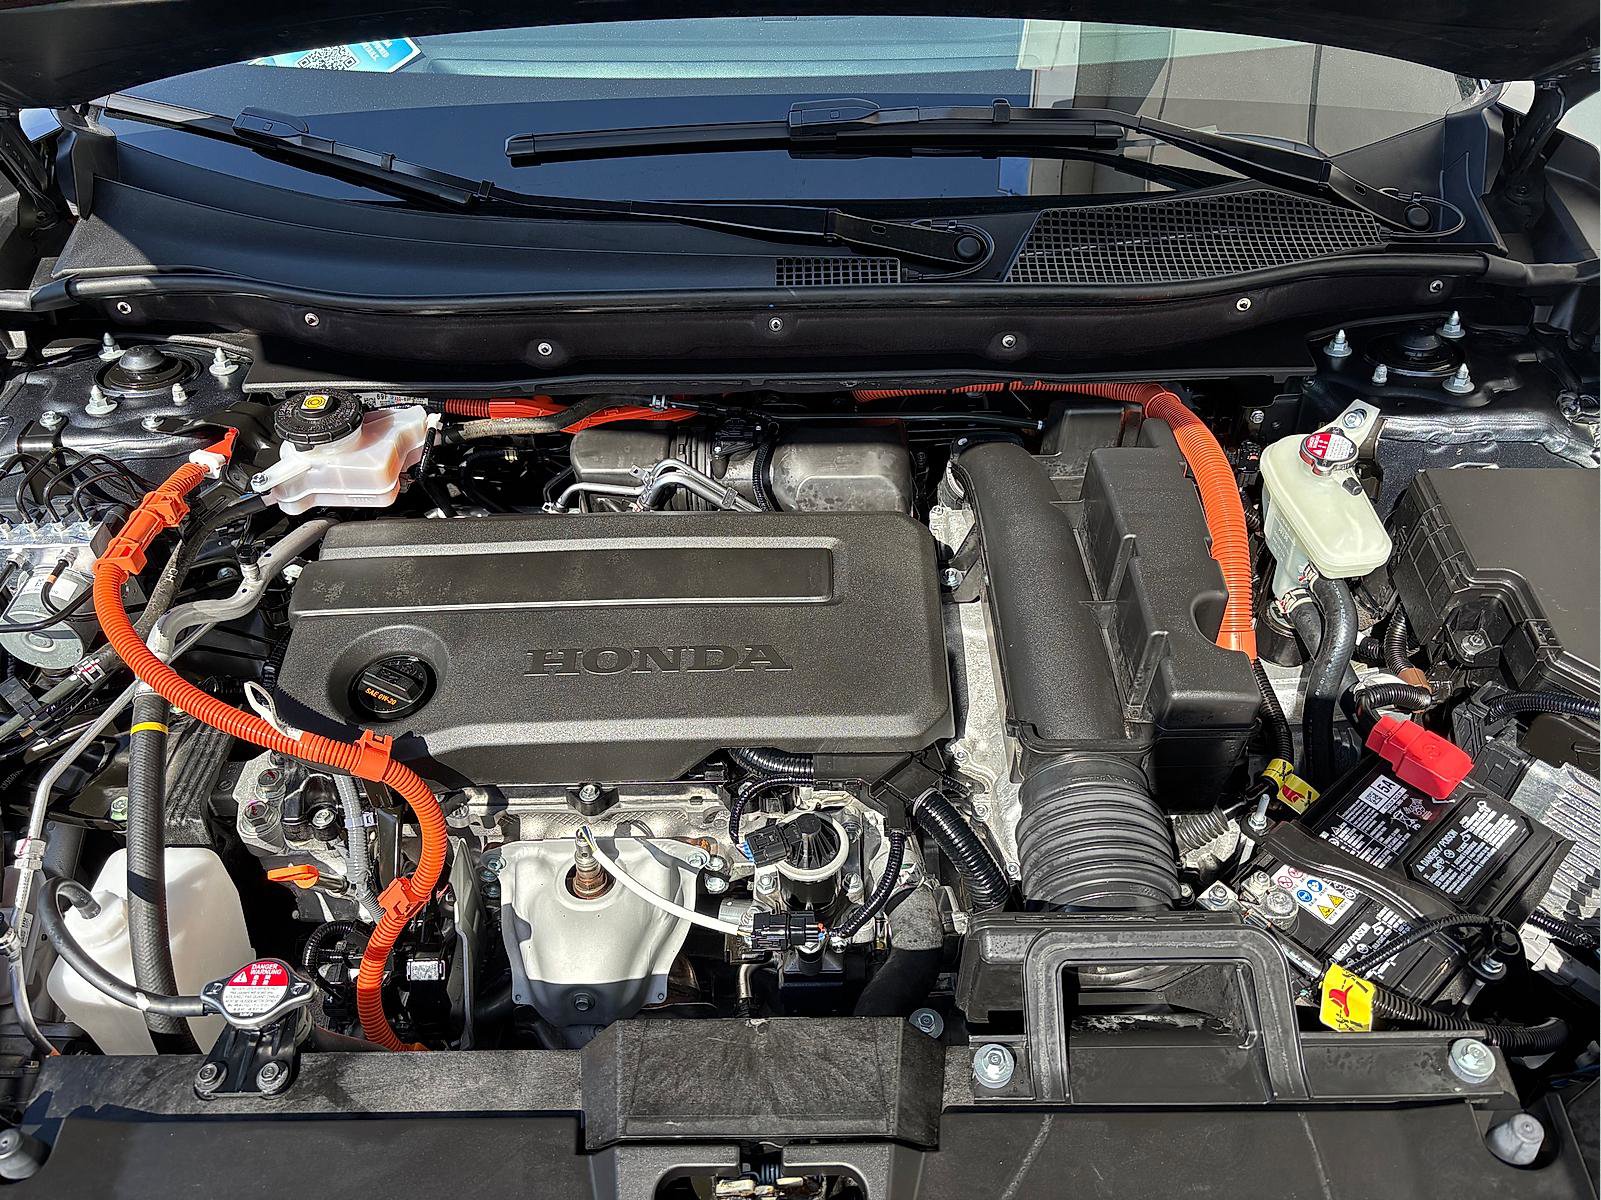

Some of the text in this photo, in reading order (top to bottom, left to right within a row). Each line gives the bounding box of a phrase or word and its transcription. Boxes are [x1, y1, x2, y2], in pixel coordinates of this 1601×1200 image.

[523, 644, 793, 677] HONDA
[365, 687, 397, 706] SAE 0W-20
[1377, 779, 1396, 794] 5A
